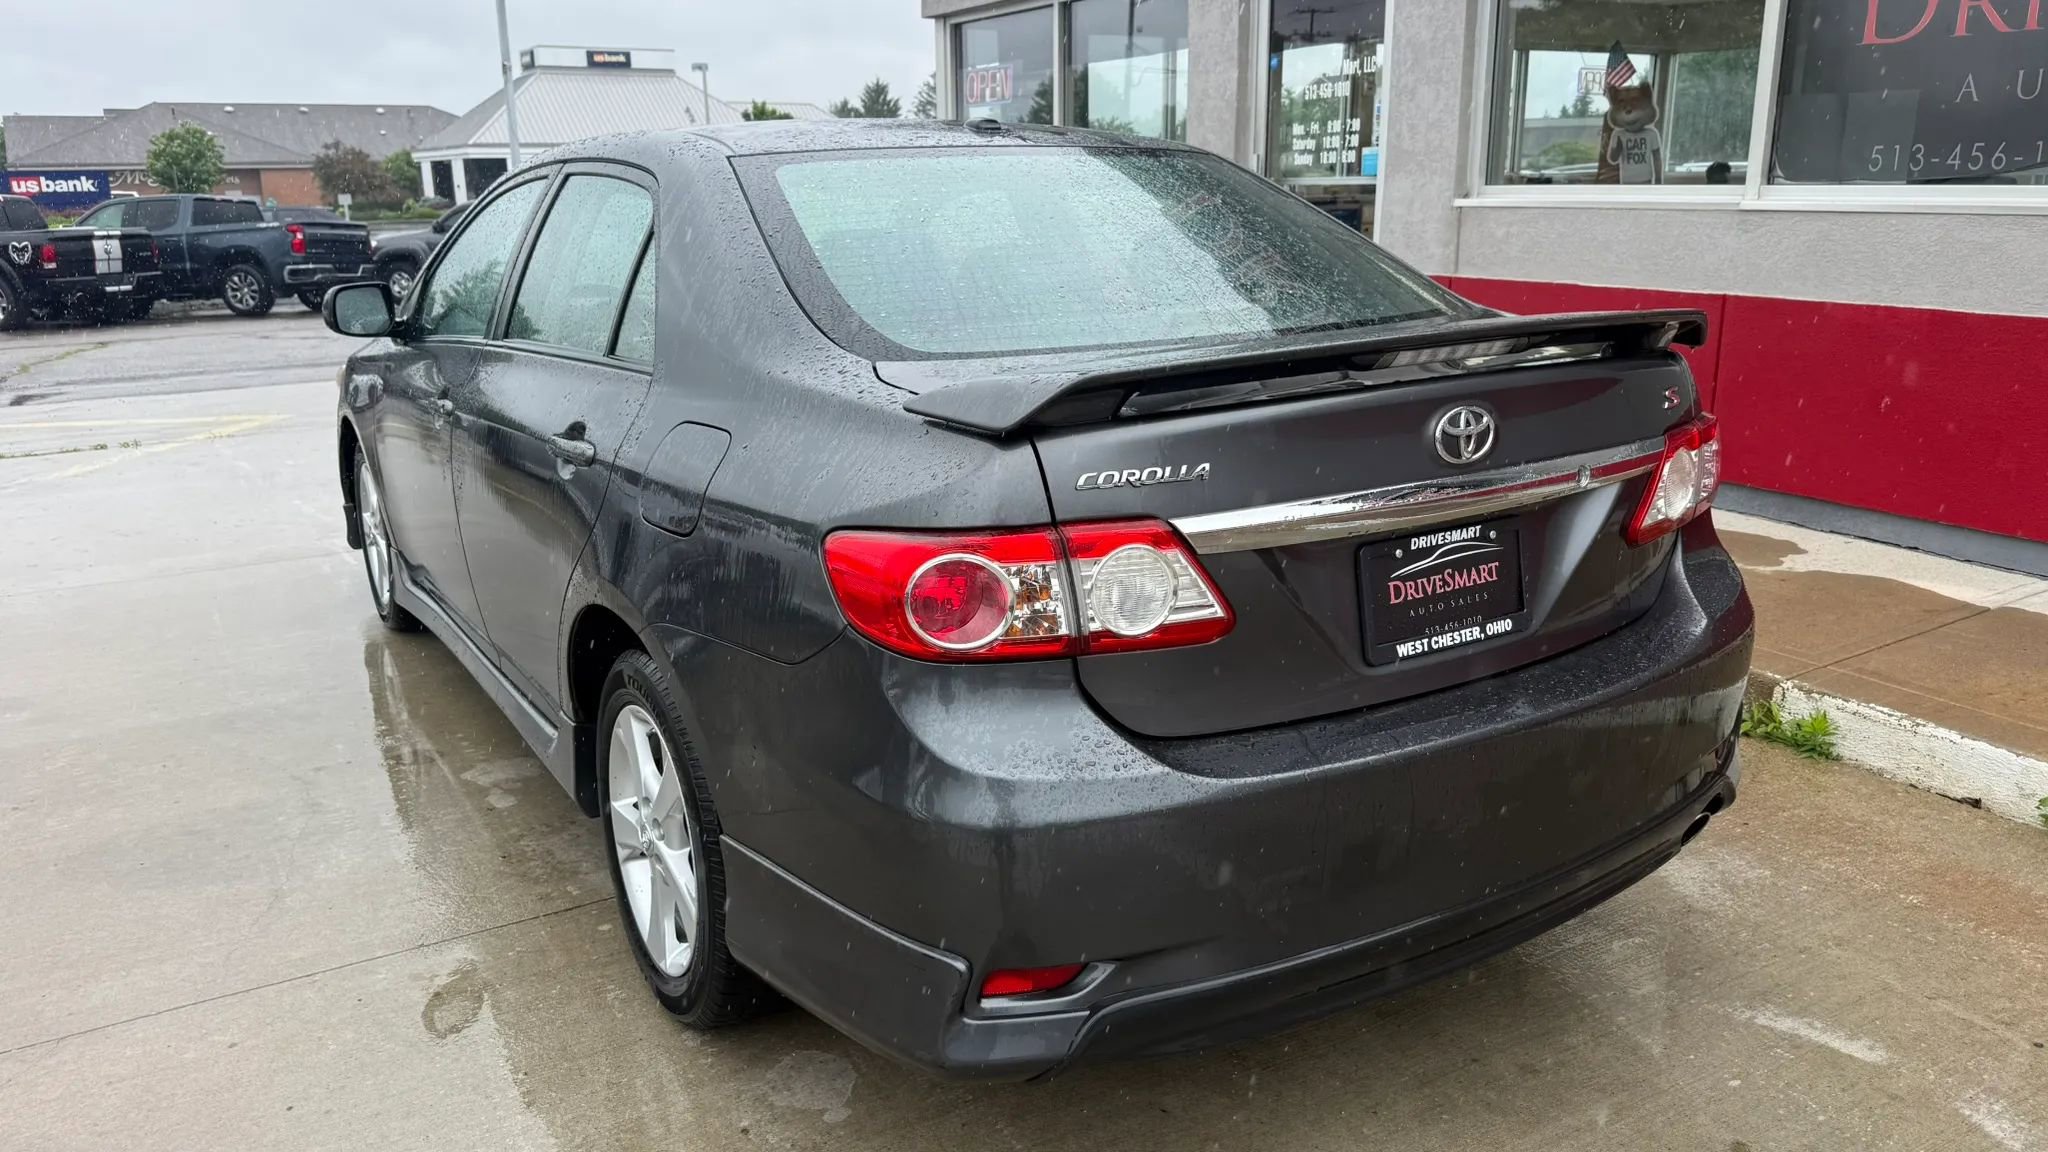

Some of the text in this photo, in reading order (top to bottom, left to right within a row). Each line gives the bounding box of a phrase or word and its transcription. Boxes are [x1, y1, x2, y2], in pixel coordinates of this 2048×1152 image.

[967, 68, 1012, 103] OPEN
[1304, 81, 1350, 100] 513-456-1010
[1626, 138, 1647, 151] CAR
[1868, 140, 2044, 172] 513-456-1
[1626, 152, 1648, 165] FOX
[11, 176, 97, 193] usbank
[1663, 386, 1680, 409] S
[1075, 463, 1210, 490] COROLLA
[1411, 525, 1481, 550] DRIVESMART
[1409, 591, 1488, 617] AUTO SALES
[1425, 615, 1482, 635] 513-456-1010
[1396, 618, 1513, 657] WEST CHESTER, OHIO
